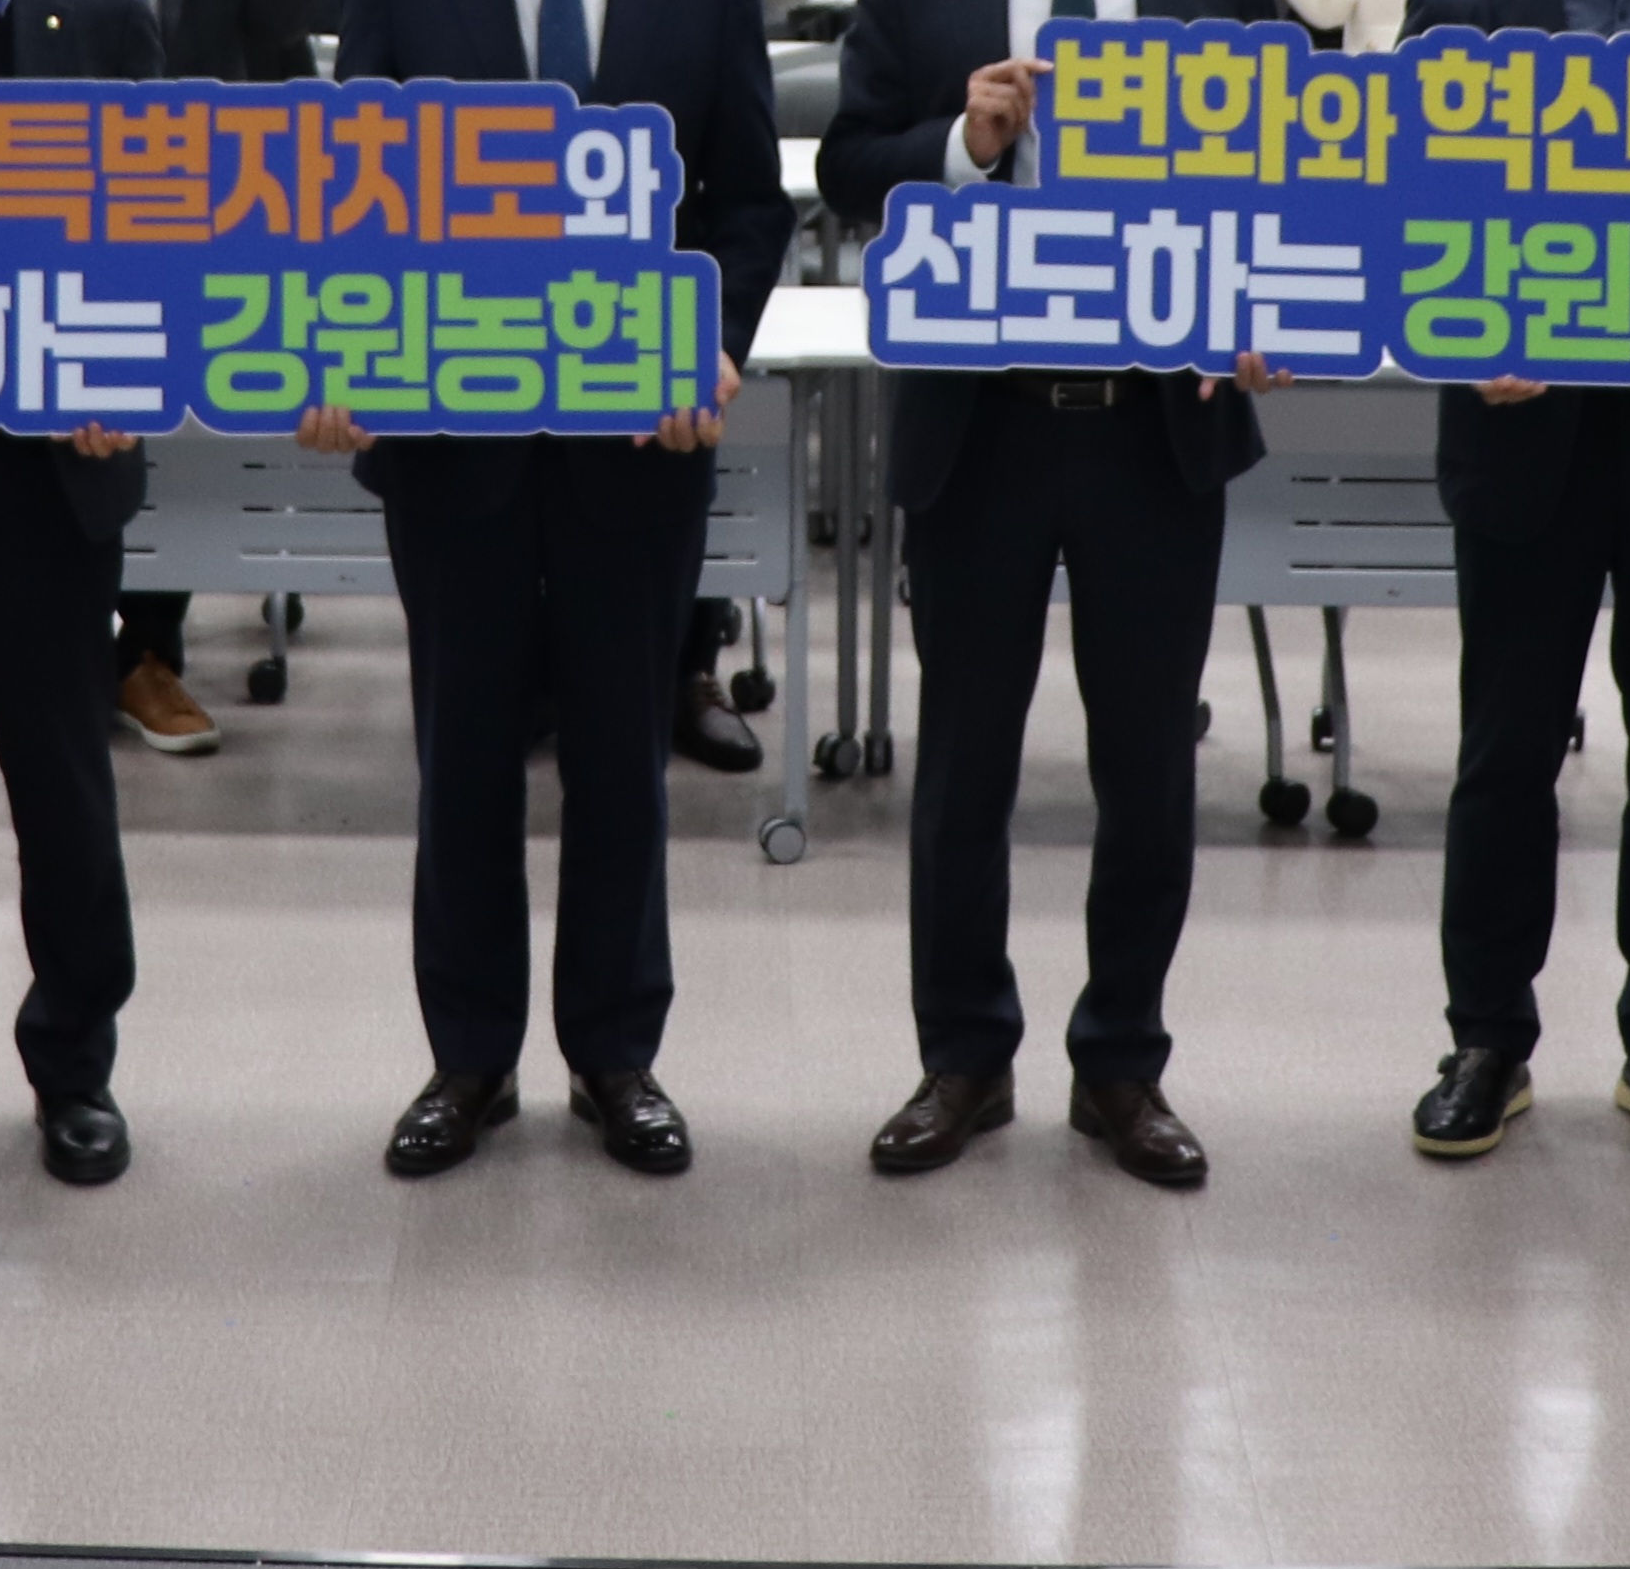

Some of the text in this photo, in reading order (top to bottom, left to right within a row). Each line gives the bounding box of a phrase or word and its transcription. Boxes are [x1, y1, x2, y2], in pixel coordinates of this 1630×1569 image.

[1053, 39, 1397, 183] 변화와
[201, 270, 698, 412] 강원농협!
[881, 201, 1366, 356] 선도하는
